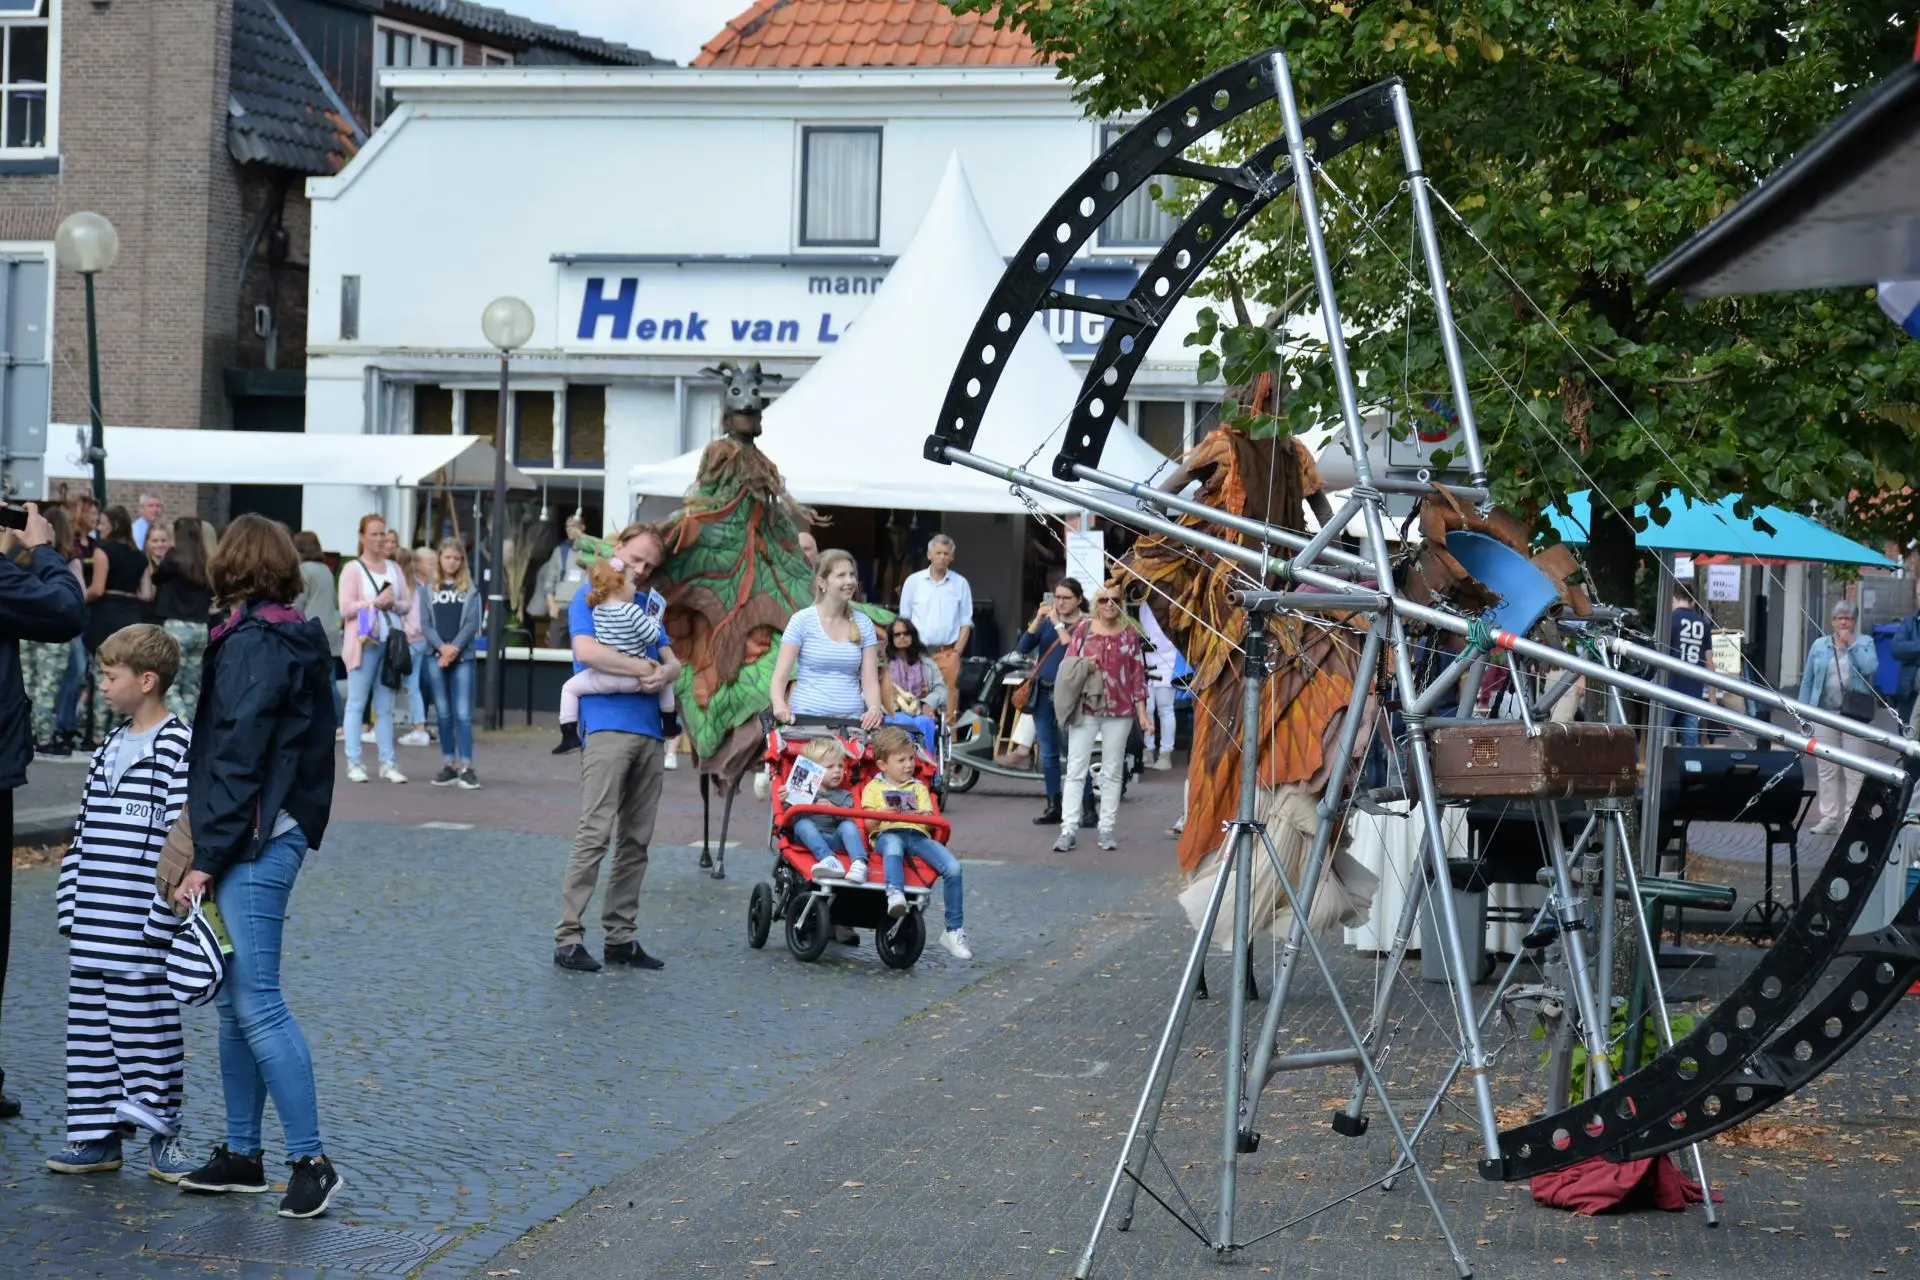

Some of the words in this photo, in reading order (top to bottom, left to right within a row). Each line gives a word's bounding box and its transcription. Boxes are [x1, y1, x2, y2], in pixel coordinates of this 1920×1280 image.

[577, 277, 708, 341] Henk
[731, 318, 800, 343] van
[817, 312, 846, 343] L
[1048, 279, 1106, 345] de
[1680, 618, 1704, 640] 20
[1680, 642, 1701, 665] 16
